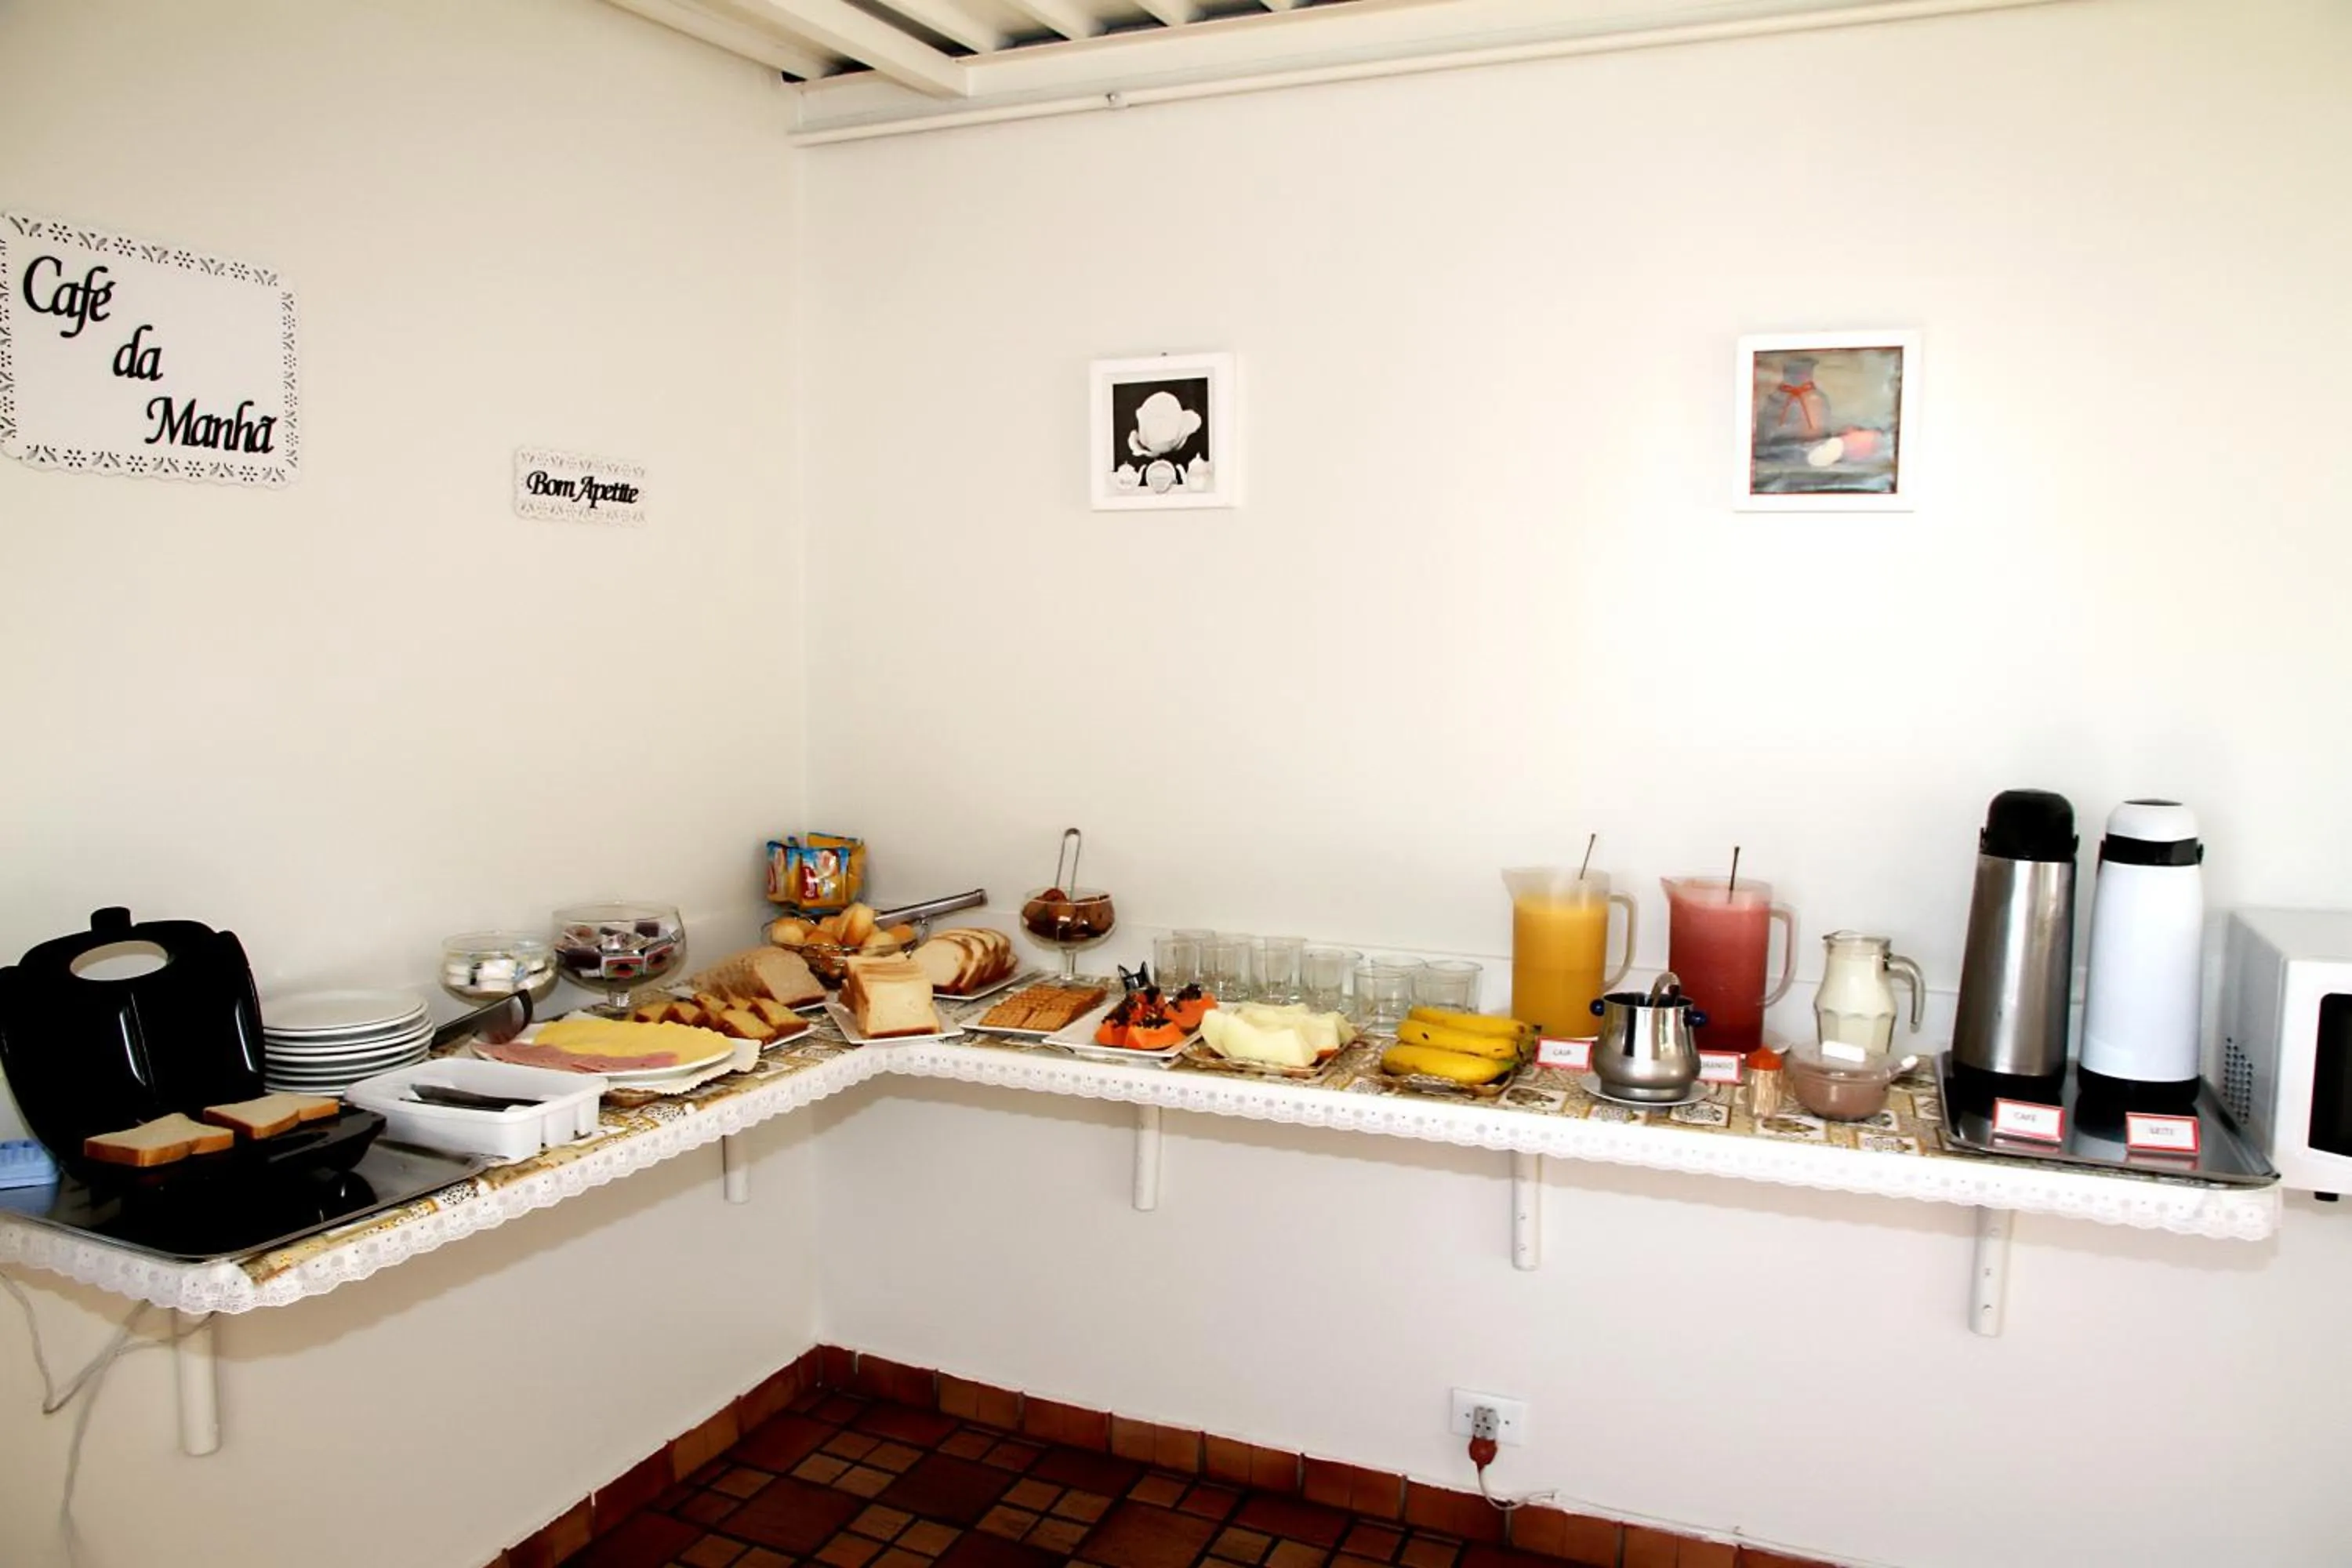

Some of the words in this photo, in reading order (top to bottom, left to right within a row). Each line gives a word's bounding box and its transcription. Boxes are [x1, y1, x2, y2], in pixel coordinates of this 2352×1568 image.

[23, 256, 115, 338] Café
[112, 325, 163, 381] da
[144, 397, 277, 454] Manhã
[526, 470, 576, 498] Bom
